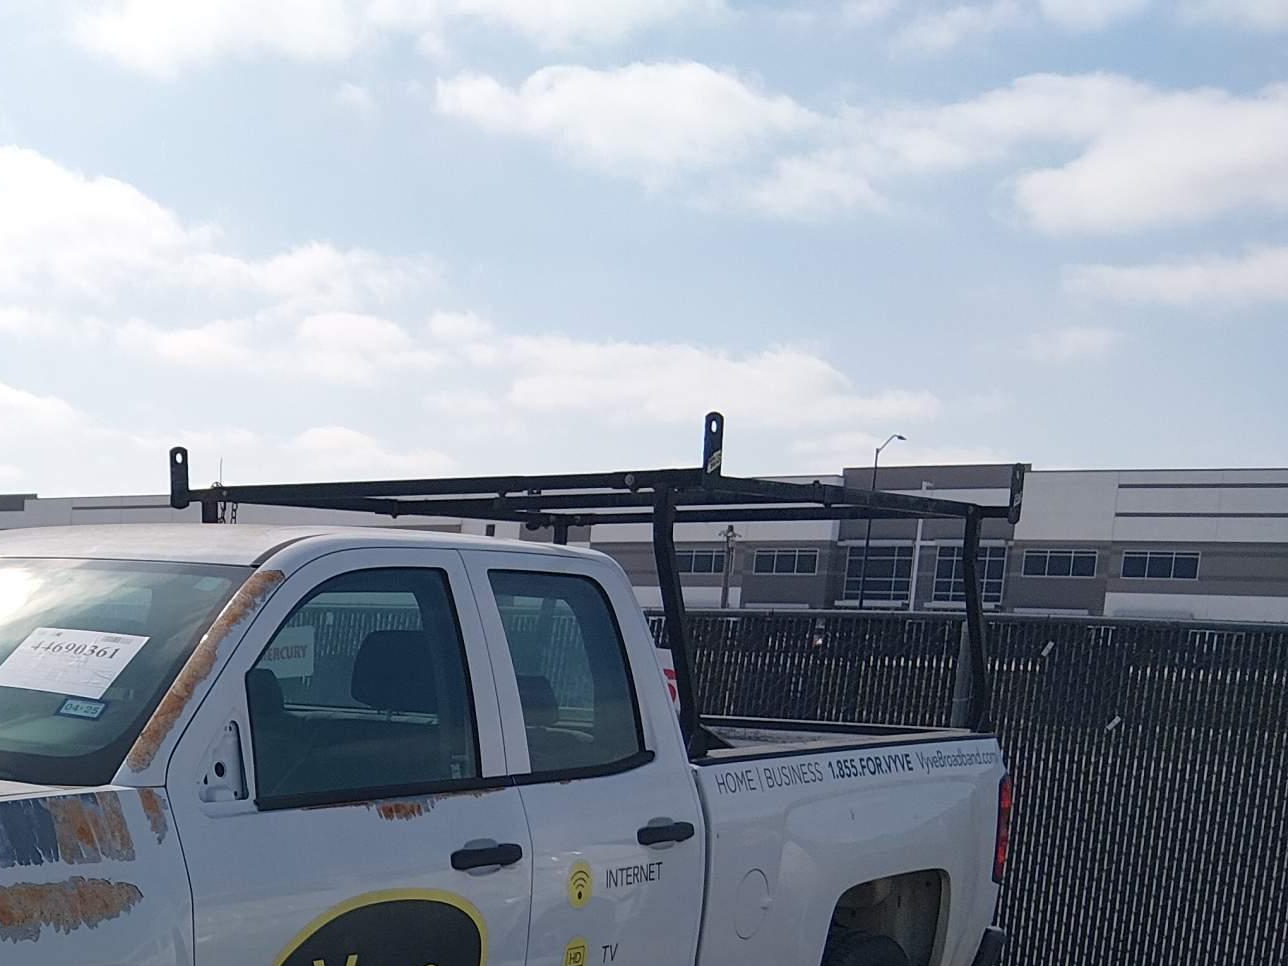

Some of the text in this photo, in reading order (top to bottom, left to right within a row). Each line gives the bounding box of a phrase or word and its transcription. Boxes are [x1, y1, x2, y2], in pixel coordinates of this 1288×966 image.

[30, 639, 121, 660] 44690361
[714, 769, 757, 795] HOME
[763, 762, 824, 788] BUSINESS
[828, 753, 914, 779] 1.855.FOR.VYVE
[606, 862, 663, 888] INTERNET
[568, 951, 582, 965] HD
[602, 943, 619, 964] TV
